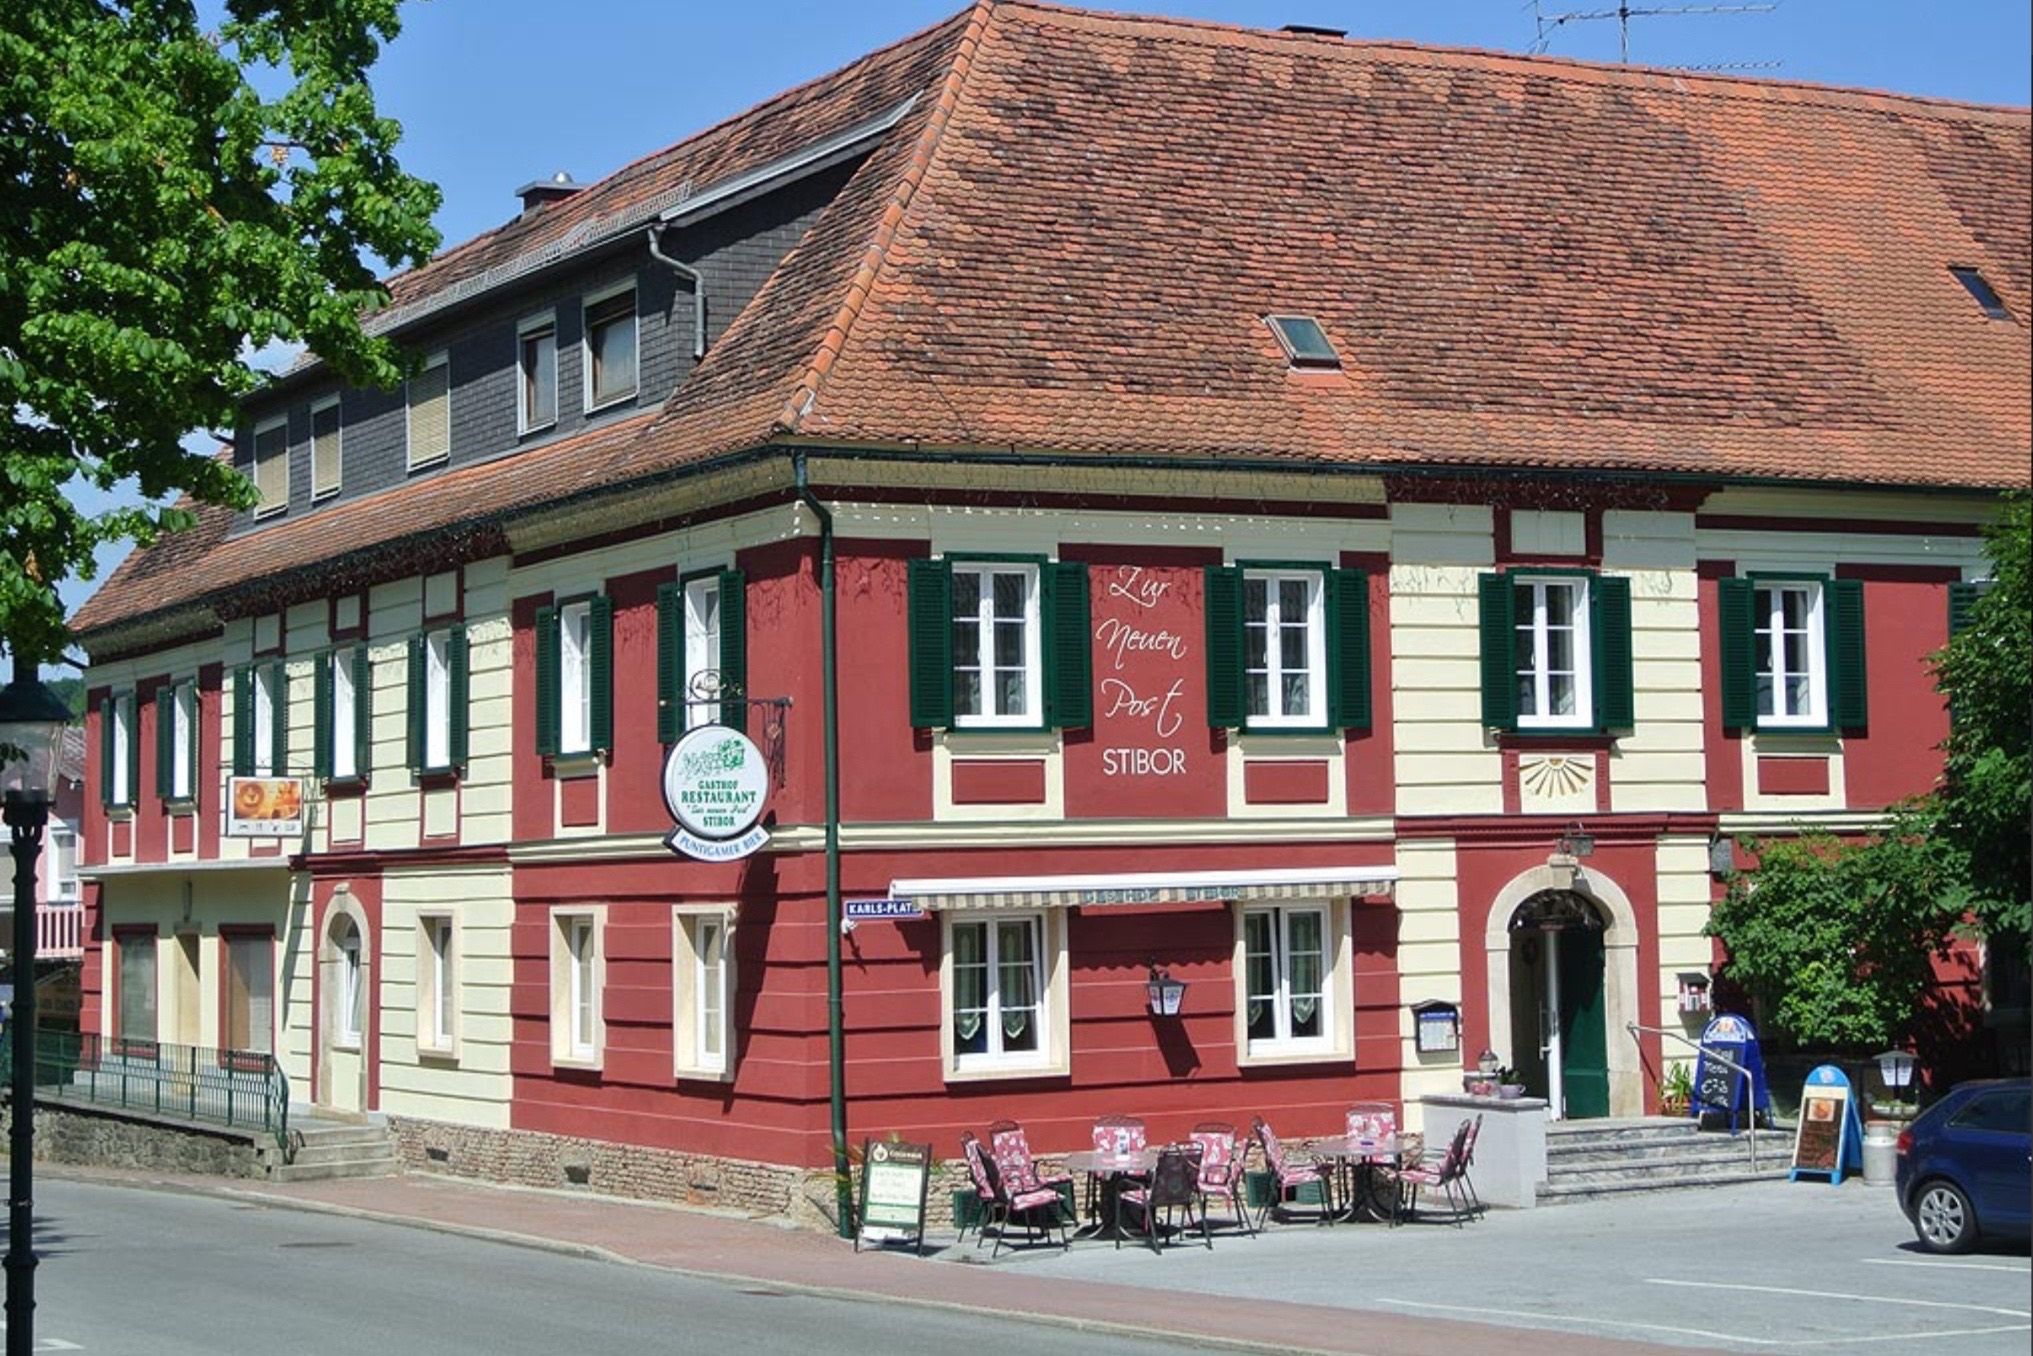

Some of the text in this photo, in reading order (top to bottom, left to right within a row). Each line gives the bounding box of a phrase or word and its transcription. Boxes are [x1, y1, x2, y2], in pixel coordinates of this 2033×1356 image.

[1109, 565, 1172, 608] Zur
[1096, 618, 1187, 670] Neuen
[1101, 678, 1184, 738] Post
[1103, 748, 1187, 776] STIBOR
[681, 790, 757, 804] RESTAURANT
[703, 816, 736, 827] STIBOR
[849, 902, 913, 915] KARLS-PLAT
